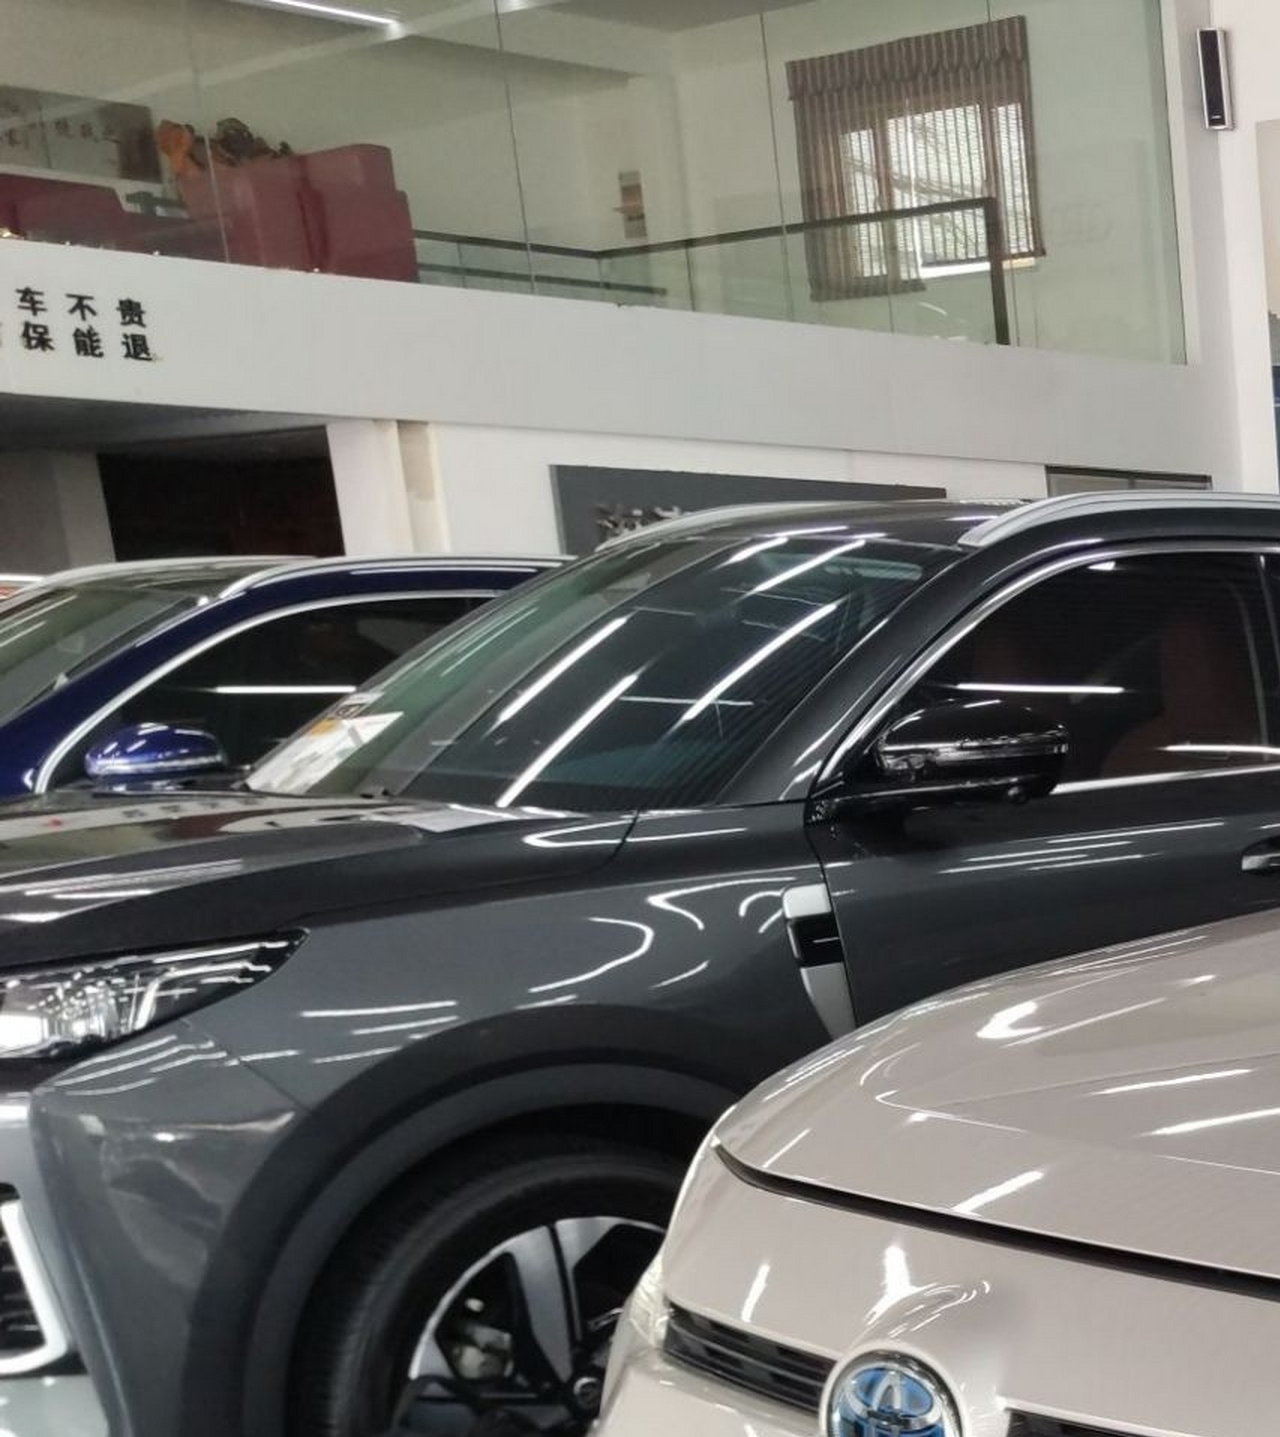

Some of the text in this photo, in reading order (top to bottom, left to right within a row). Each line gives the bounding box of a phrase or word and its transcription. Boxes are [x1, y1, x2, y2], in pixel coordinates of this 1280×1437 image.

[15, 286, 147, 328] 车不贵
[0, 320, 153, 361] 保能退
